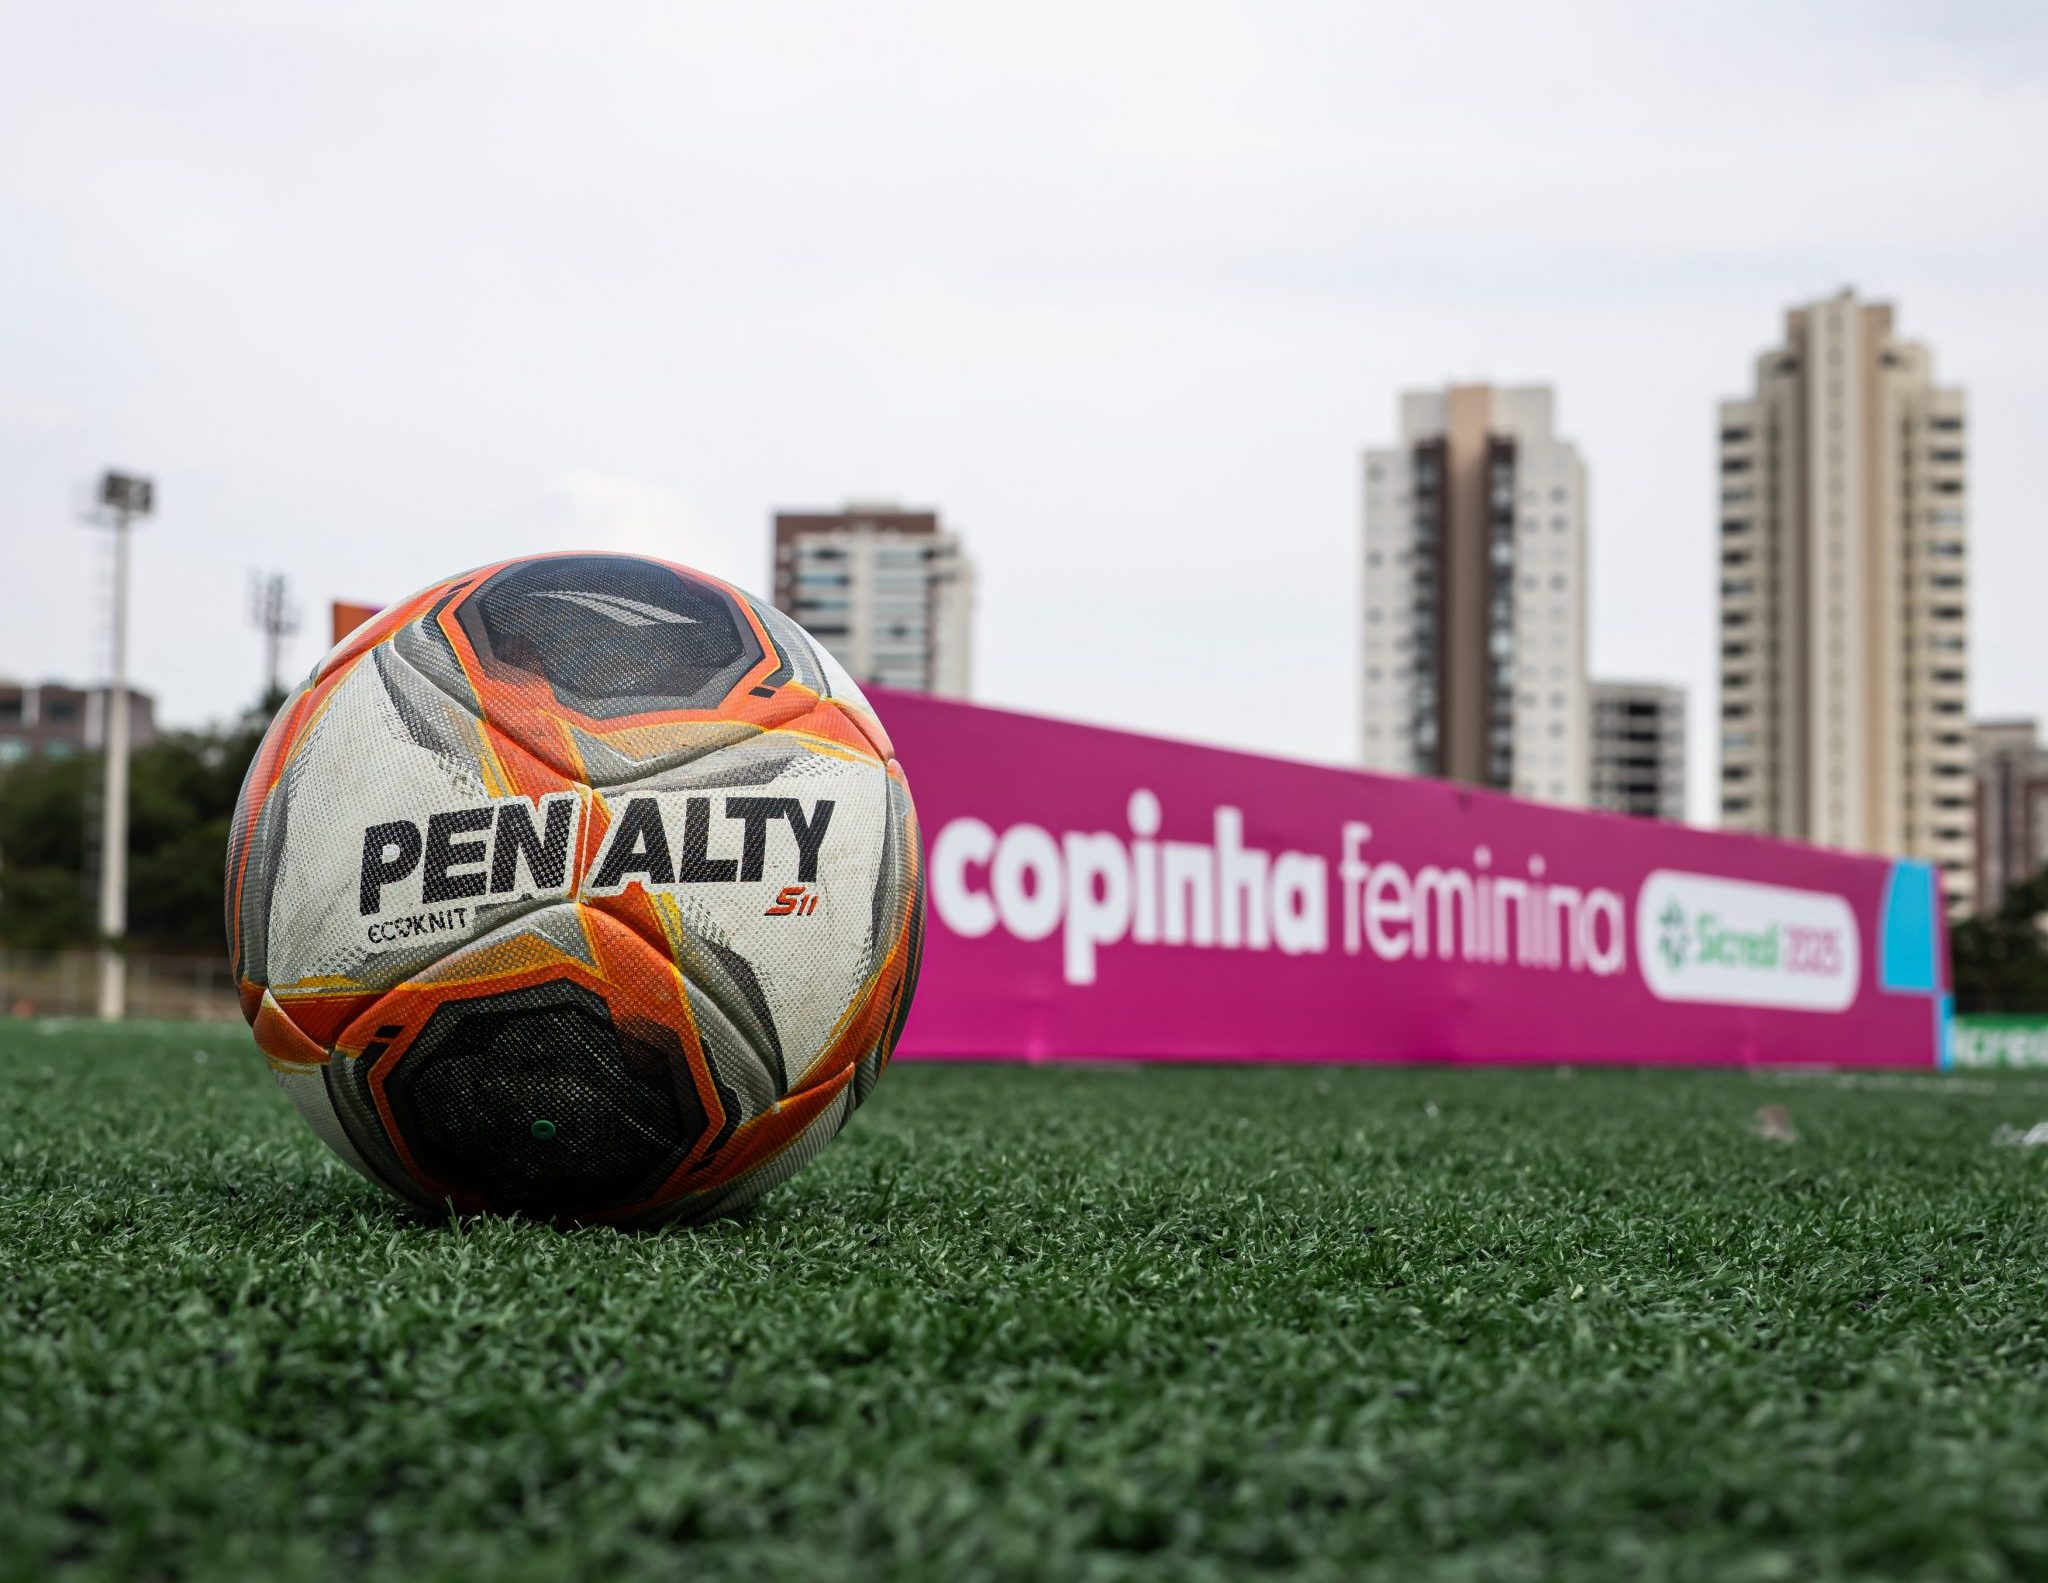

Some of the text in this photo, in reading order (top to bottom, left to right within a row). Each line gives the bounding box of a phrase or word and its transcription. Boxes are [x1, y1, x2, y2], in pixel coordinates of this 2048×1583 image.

[359, 797, 836, 916] PENALTY
[931, 789, 1626, 985] copinha feminina
